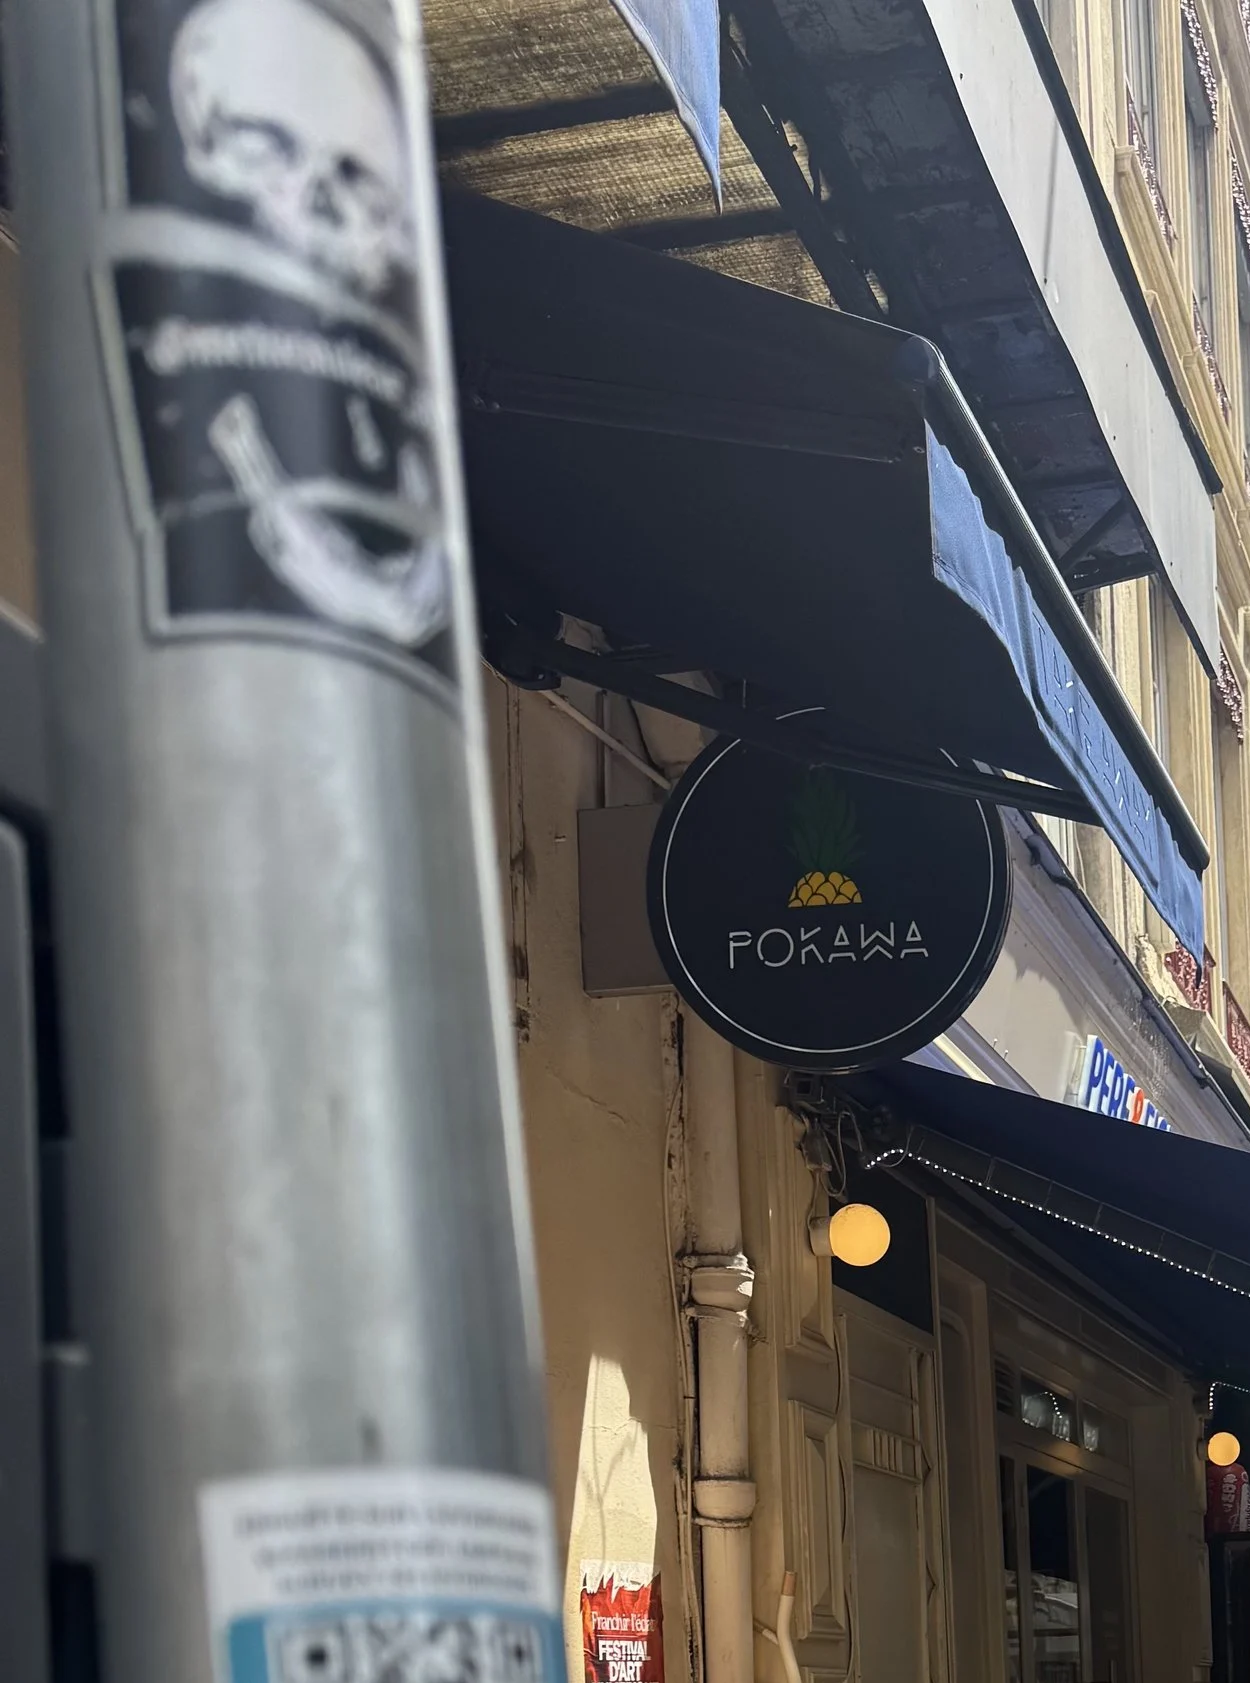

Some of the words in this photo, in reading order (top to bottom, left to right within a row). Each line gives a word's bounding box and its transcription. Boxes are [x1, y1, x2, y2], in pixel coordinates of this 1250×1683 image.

[728, 919, 929, 970] POKAWA
[591, 1610, 630, 1632] Franchir
[598, 1640, 651, 1661] FESTIVAL
[608, 1661, 643, 1682] D'ART
